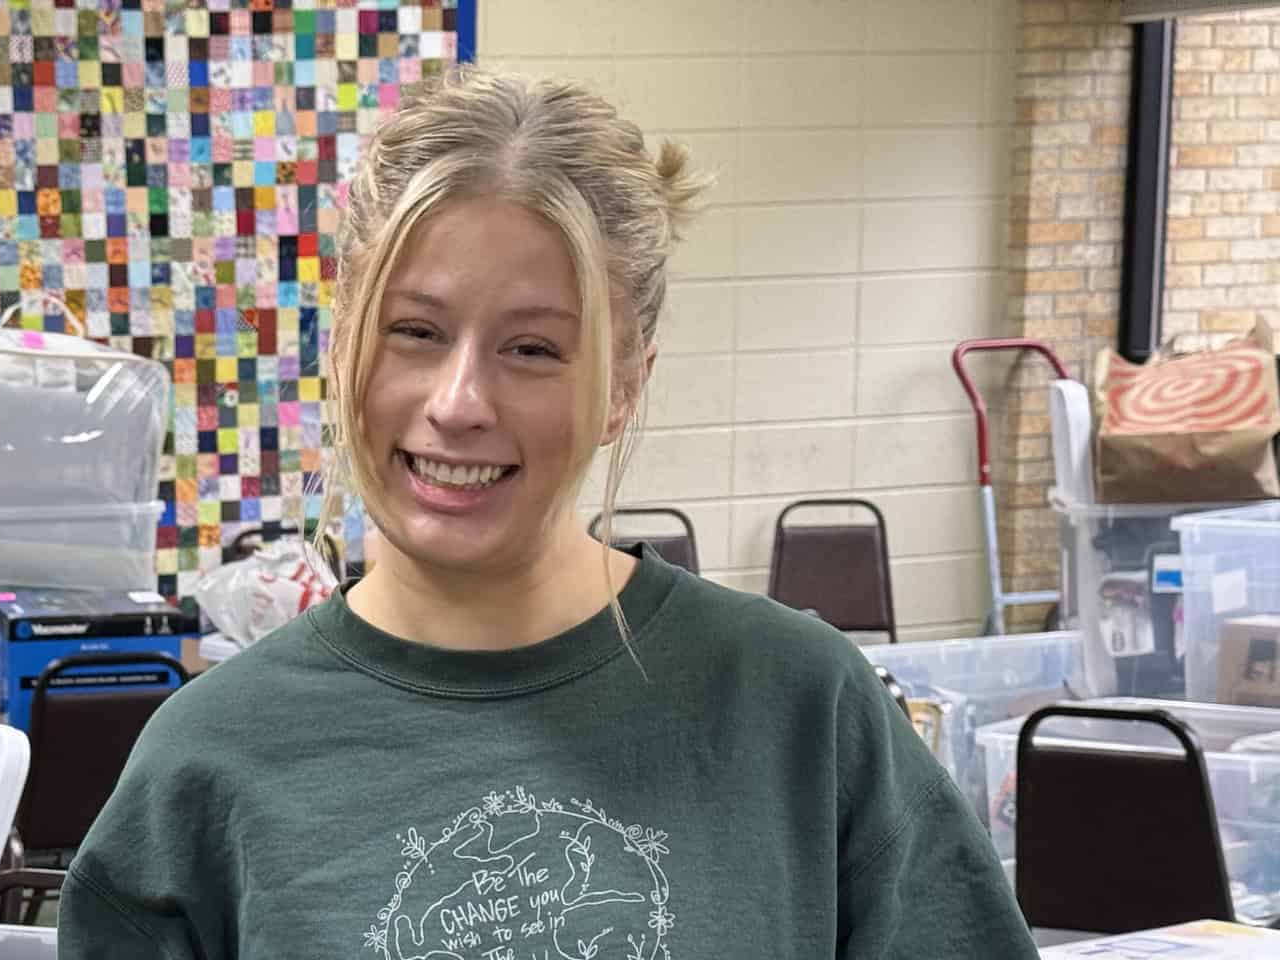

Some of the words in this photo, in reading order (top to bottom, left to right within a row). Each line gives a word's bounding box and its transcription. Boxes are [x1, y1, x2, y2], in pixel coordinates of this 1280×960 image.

[472, 869, 506, 895] Be
[508, 852, 549, 887] The
[440, 895, 521, 934] CHANGE
[529, 889, 560, 923] you
[441, 931, 482, 951] wish
[492, 925, 512, 943] to
[520, 919, 545, 938] see
[547, 911, 566, 930] in
